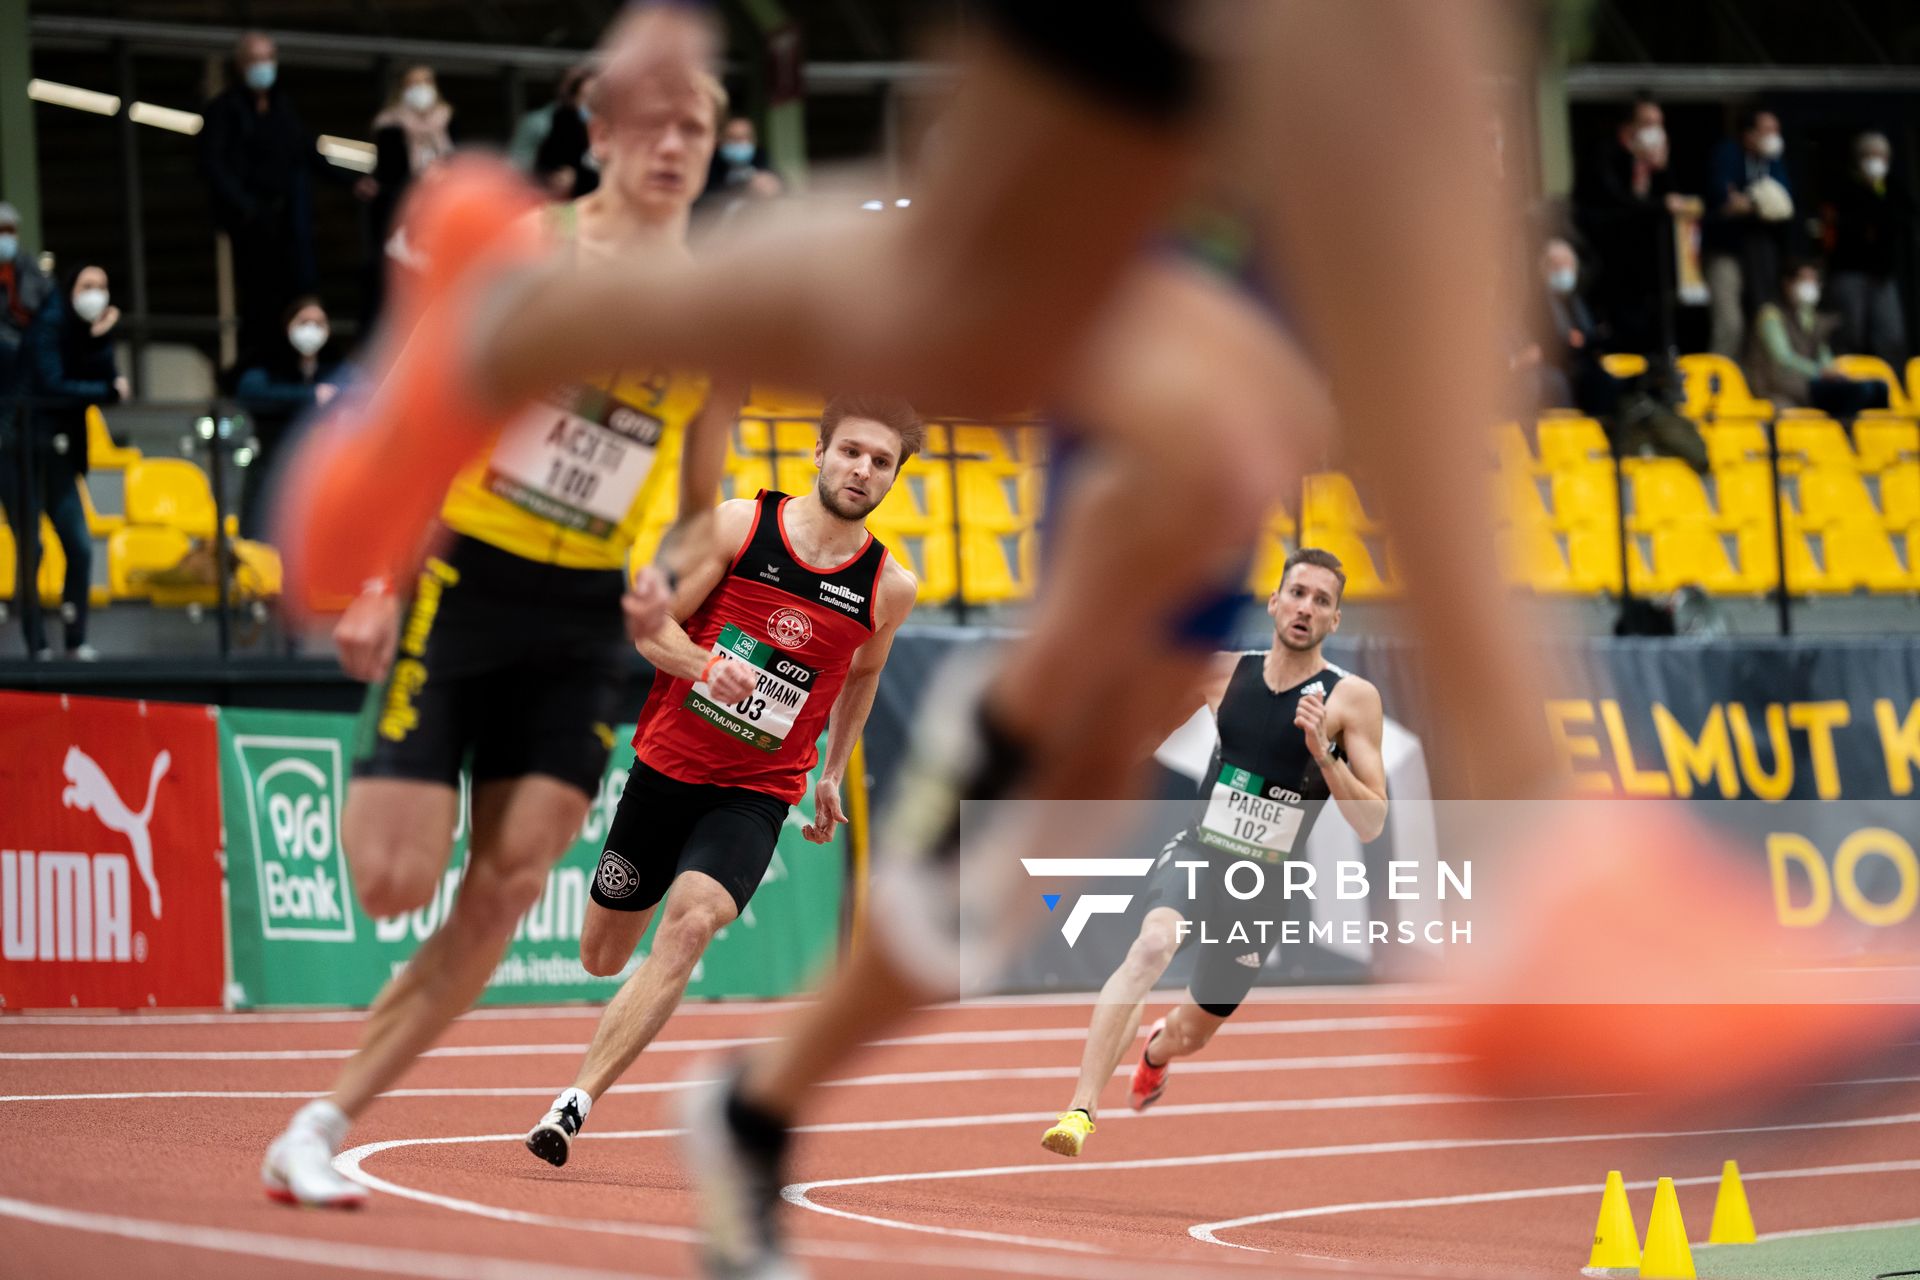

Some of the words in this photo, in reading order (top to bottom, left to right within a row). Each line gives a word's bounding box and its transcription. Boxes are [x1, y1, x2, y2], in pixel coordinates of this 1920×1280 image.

[760, 571, 780, 583] erima
[819, 593, 859, 614] Laufanalyse
[734, 643, 749, 656] Bank
[776, 660, 809, 682] GfTD
[692, 699, 740, 733] DORTMUND
[741, 728, 755, 741] 22
[1543, 699, 1851, 802] ELMUT
[1873, 698, 1920, 796] K
[1228, 791, 1284, 824] PARGE
[1269, 786, 1301, 804] GfTD
[1203, 832, 1251, 855] DORTMUND
[1233, 818, 1267, 844] 102
[1766, 827, 1920, 928] DO
[264, 861, 341, 921] Bank
[0, 850, 132, 961] UMA
